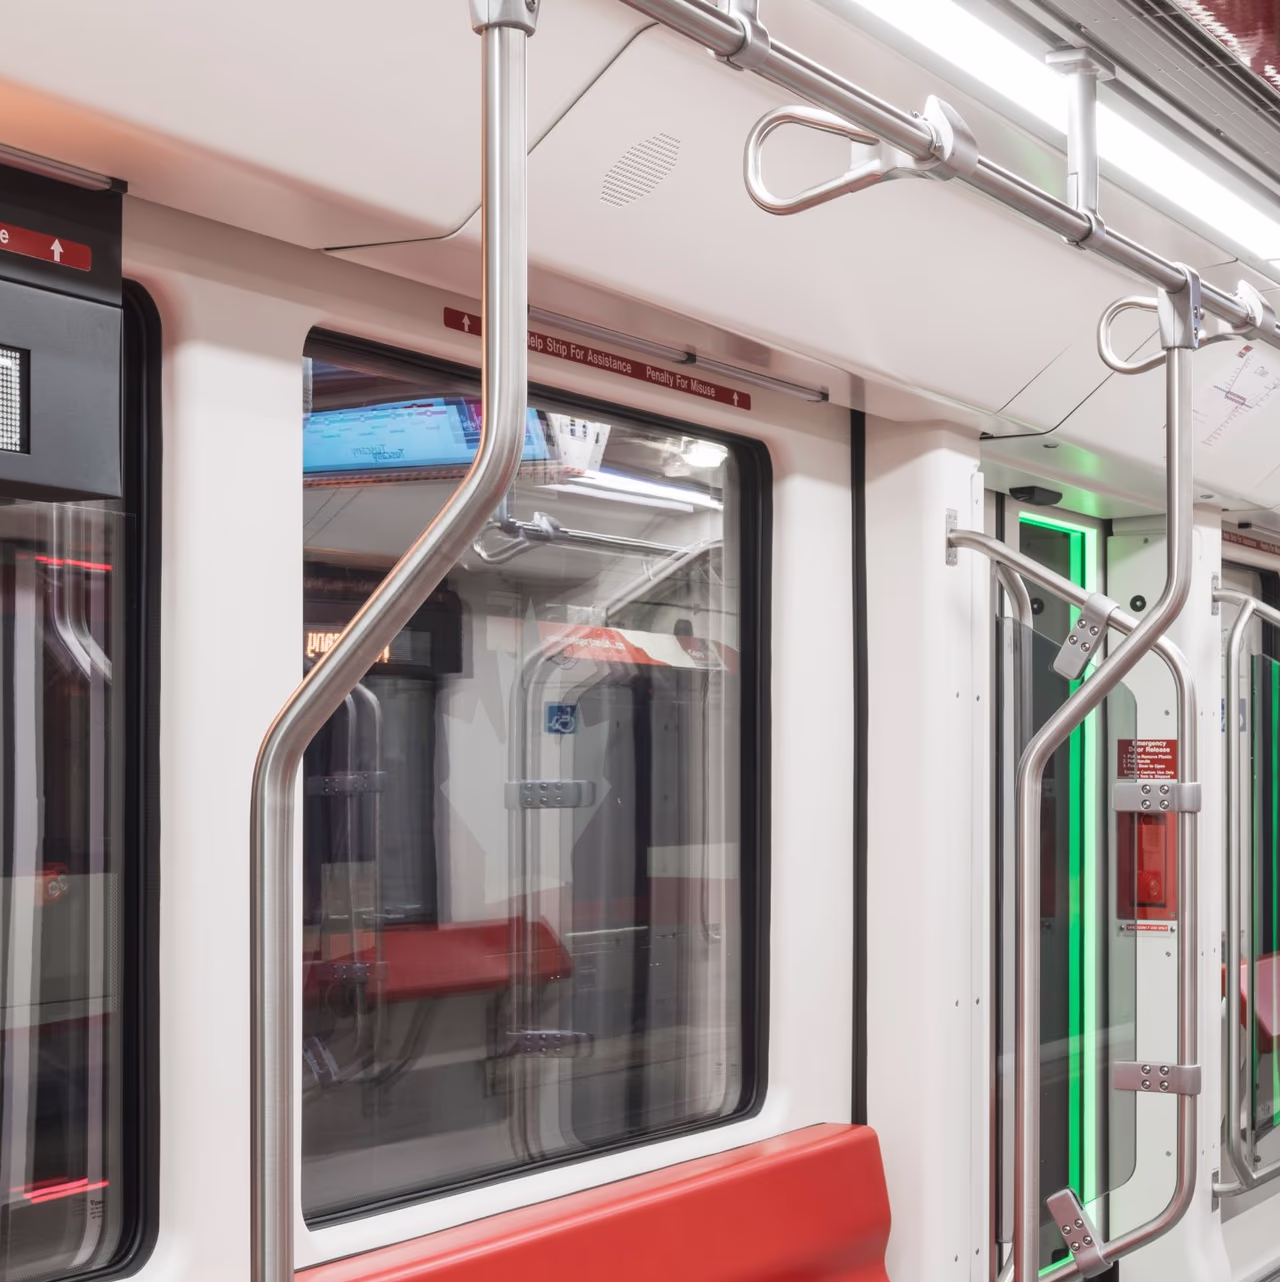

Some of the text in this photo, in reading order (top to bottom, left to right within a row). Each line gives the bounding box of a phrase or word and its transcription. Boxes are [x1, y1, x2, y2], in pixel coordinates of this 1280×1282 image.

[546, 337, 567, 357] Strip
[570, 343, 585, 360] For
[587, 349, 632, 373] Assistance
[646, 365, 715, 398] Penalty For Misuse
